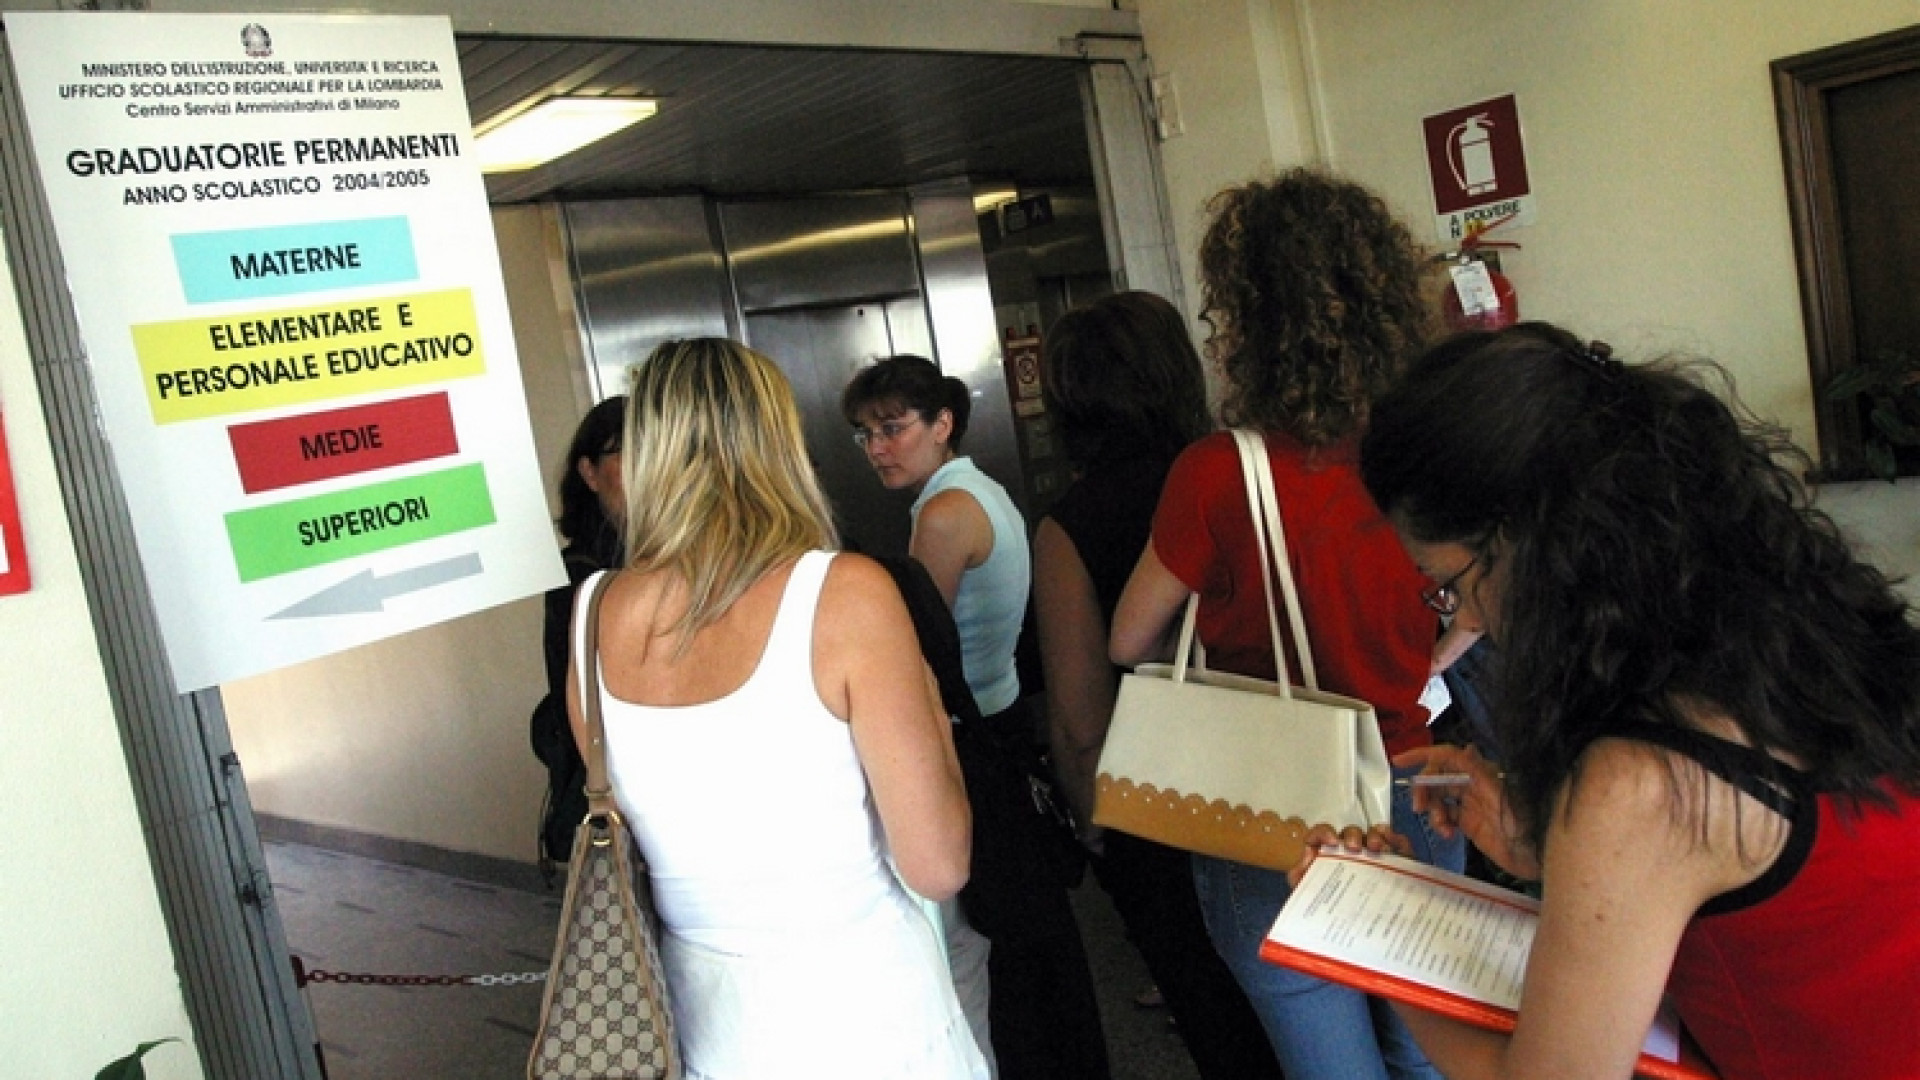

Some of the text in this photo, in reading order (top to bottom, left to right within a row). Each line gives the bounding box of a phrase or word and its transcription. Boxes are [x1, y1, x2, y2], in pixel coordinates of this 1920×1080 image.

[81, 62, 167, 78] MINISTERO
[372, 61, 380, 75] E
[383, 60, 439, 75] RICERCA
[58, 78, 443, 99] UFFICIO SCOLASTICO REGIONALE PER LA LOMBARDIA
[125, 97, 400, 118] Centro Servizi Amministrativi di Milano
[66, 133, 460, 177] GRADUATORIE PERMANENTI
[123, 168, 430, 205] ANNO SCOLASTICO 2004/2005
[1464, 200, 1520, 223] POLVERE
[230, 242, 361, 280] MATERNE
[209, 302, 413, 351] ELEMENTARE E
[156, 333, 475, 399] PERSONALE EDUCATIVO
[300, 424, 383, 461] MEDIE
[297, 496, 430, 546] SUPERIORI
